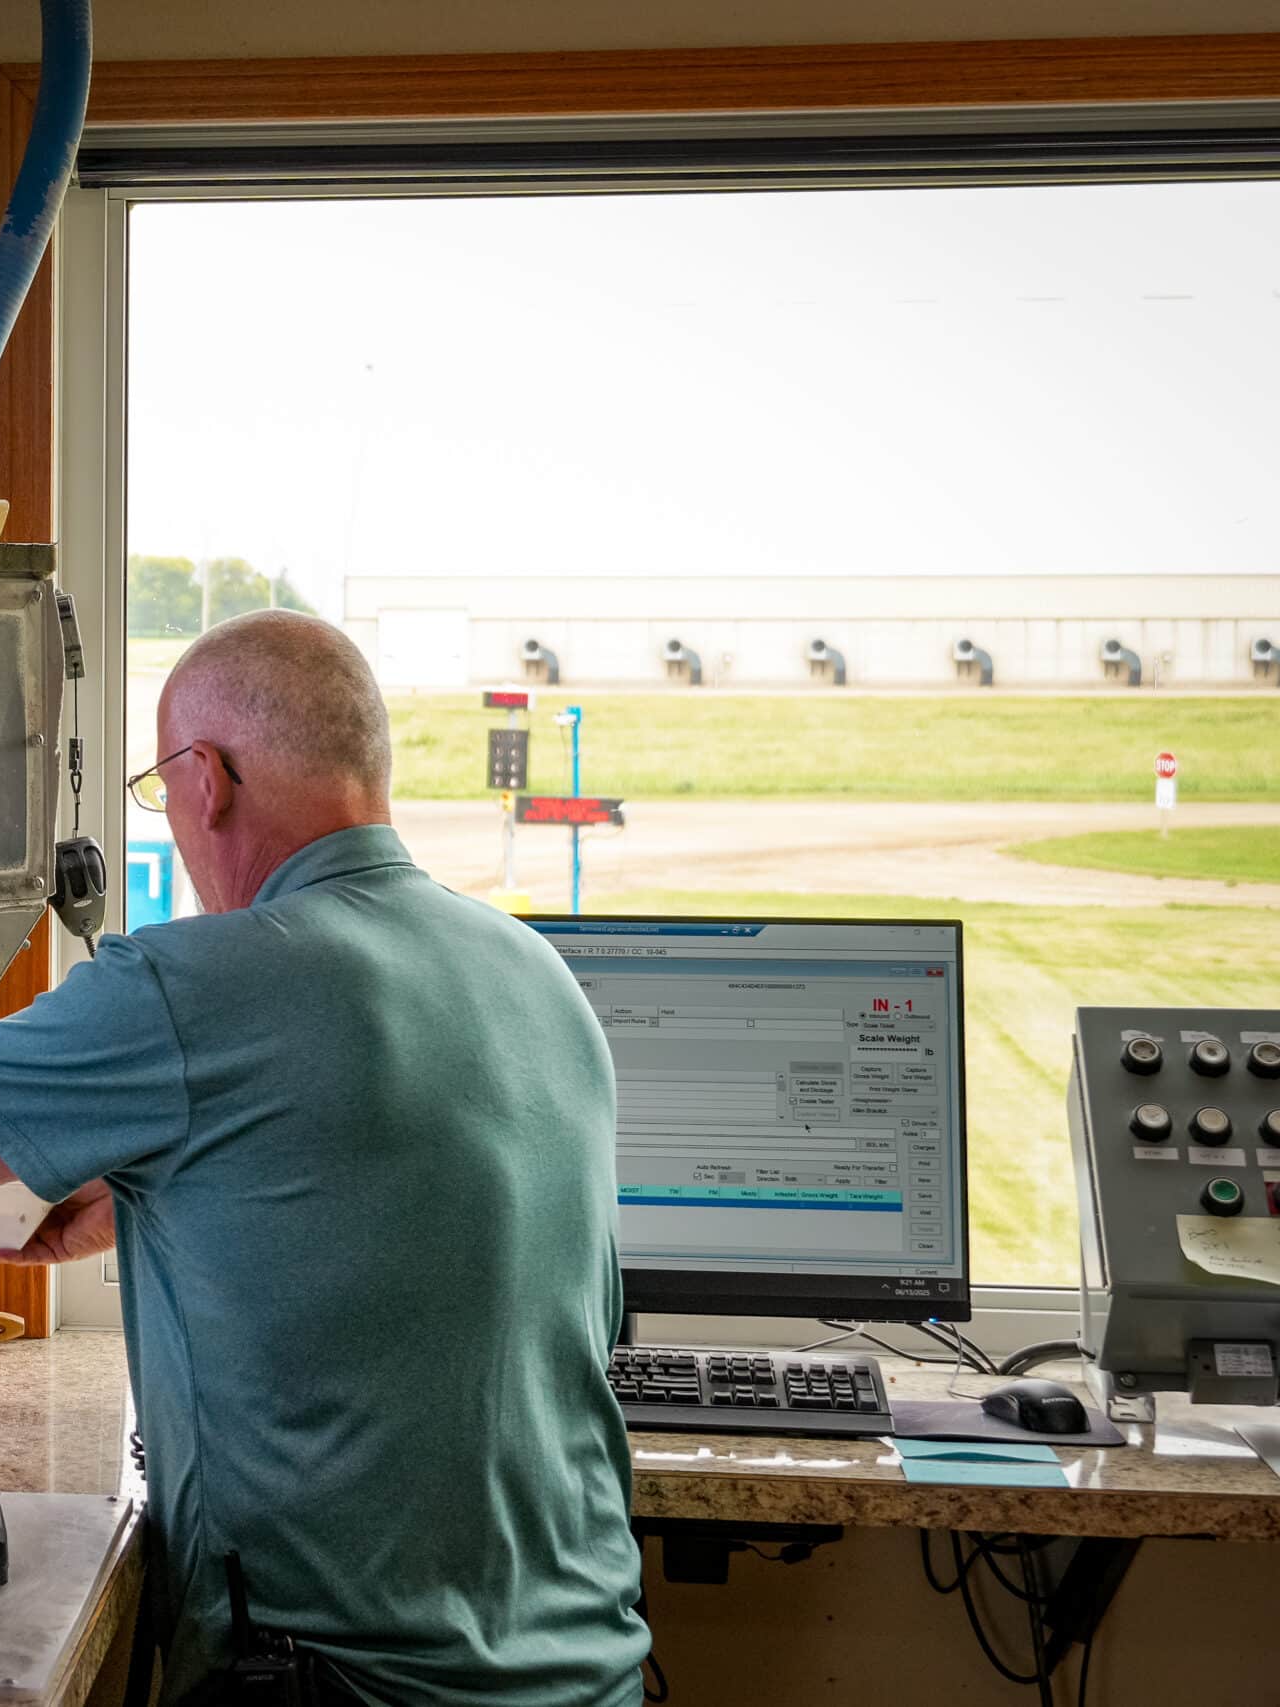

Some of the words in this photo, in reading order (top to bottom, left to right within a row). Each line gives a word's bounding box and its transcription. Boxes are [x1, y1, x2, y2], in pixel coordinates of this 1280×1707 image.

[1156, 760, 1176, 772] STOP
[873, 998, 889, 1012] IN
[904, 999, 912, 1012] 1
[858, 1034, 885, 1042] Scale
[887, 1034, 921, 1045] Weight
